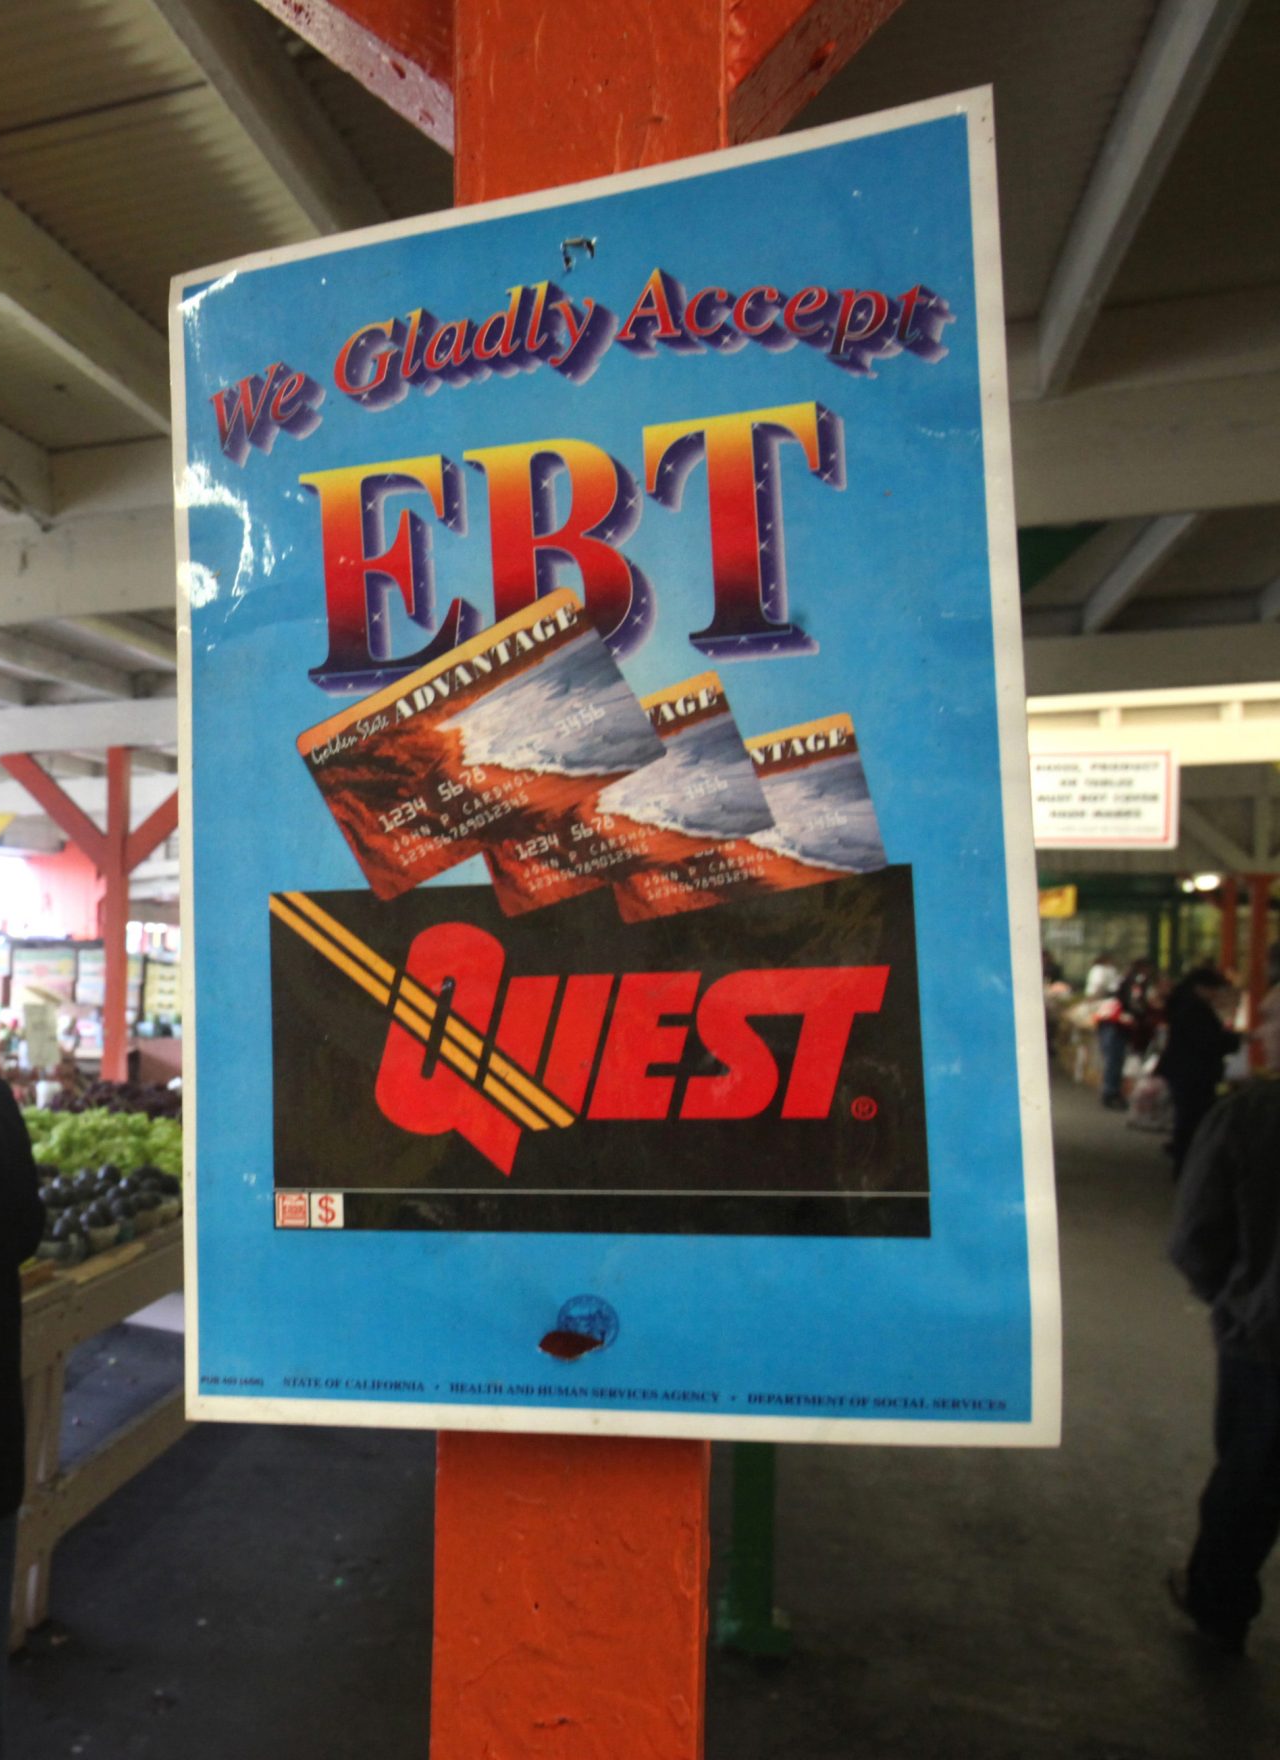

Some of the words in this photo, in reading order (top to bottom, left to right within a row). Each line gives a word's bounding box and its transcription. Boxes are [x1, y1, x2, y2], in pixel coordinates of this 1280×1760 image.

[210, 361, 320, 463] We
[333, 280, 612, 404] Gladly
[619, 267, 952, 375] Accept
[298, 401, 841, 692] EBT
[394, 605, 580, 725] ADVANTAGE
[377, 796, 428, 833] 1234
[437, 766, 488, 802] 5678
[514, 833, 559, 861] 1234
[571, 815, 615, 842] 5678
[375, 921, 892, 1177] QUEST
[283, 1376, 321, 1389] STATE
[324, 1378, 341, 1389] OF
[345, 1378, 425, 1392] CALIFORNIA
[449, 1381, 503, 1395] HEALTH
[507, 1384, 534, 1396] AND
[538, 1385, 588, 1398] HUMAN
[592, 1387, 658, 1400] SERVICES
[661, 1389, 720, 1403] AGENCY
[747, 1392, 845, 1408] DEPARTMENT
[849, 1395, 868, 1408] OF
[874, 1396, 926, 1410] SOCIAL
[932, 1397, 1008, 1411] SERVICES
